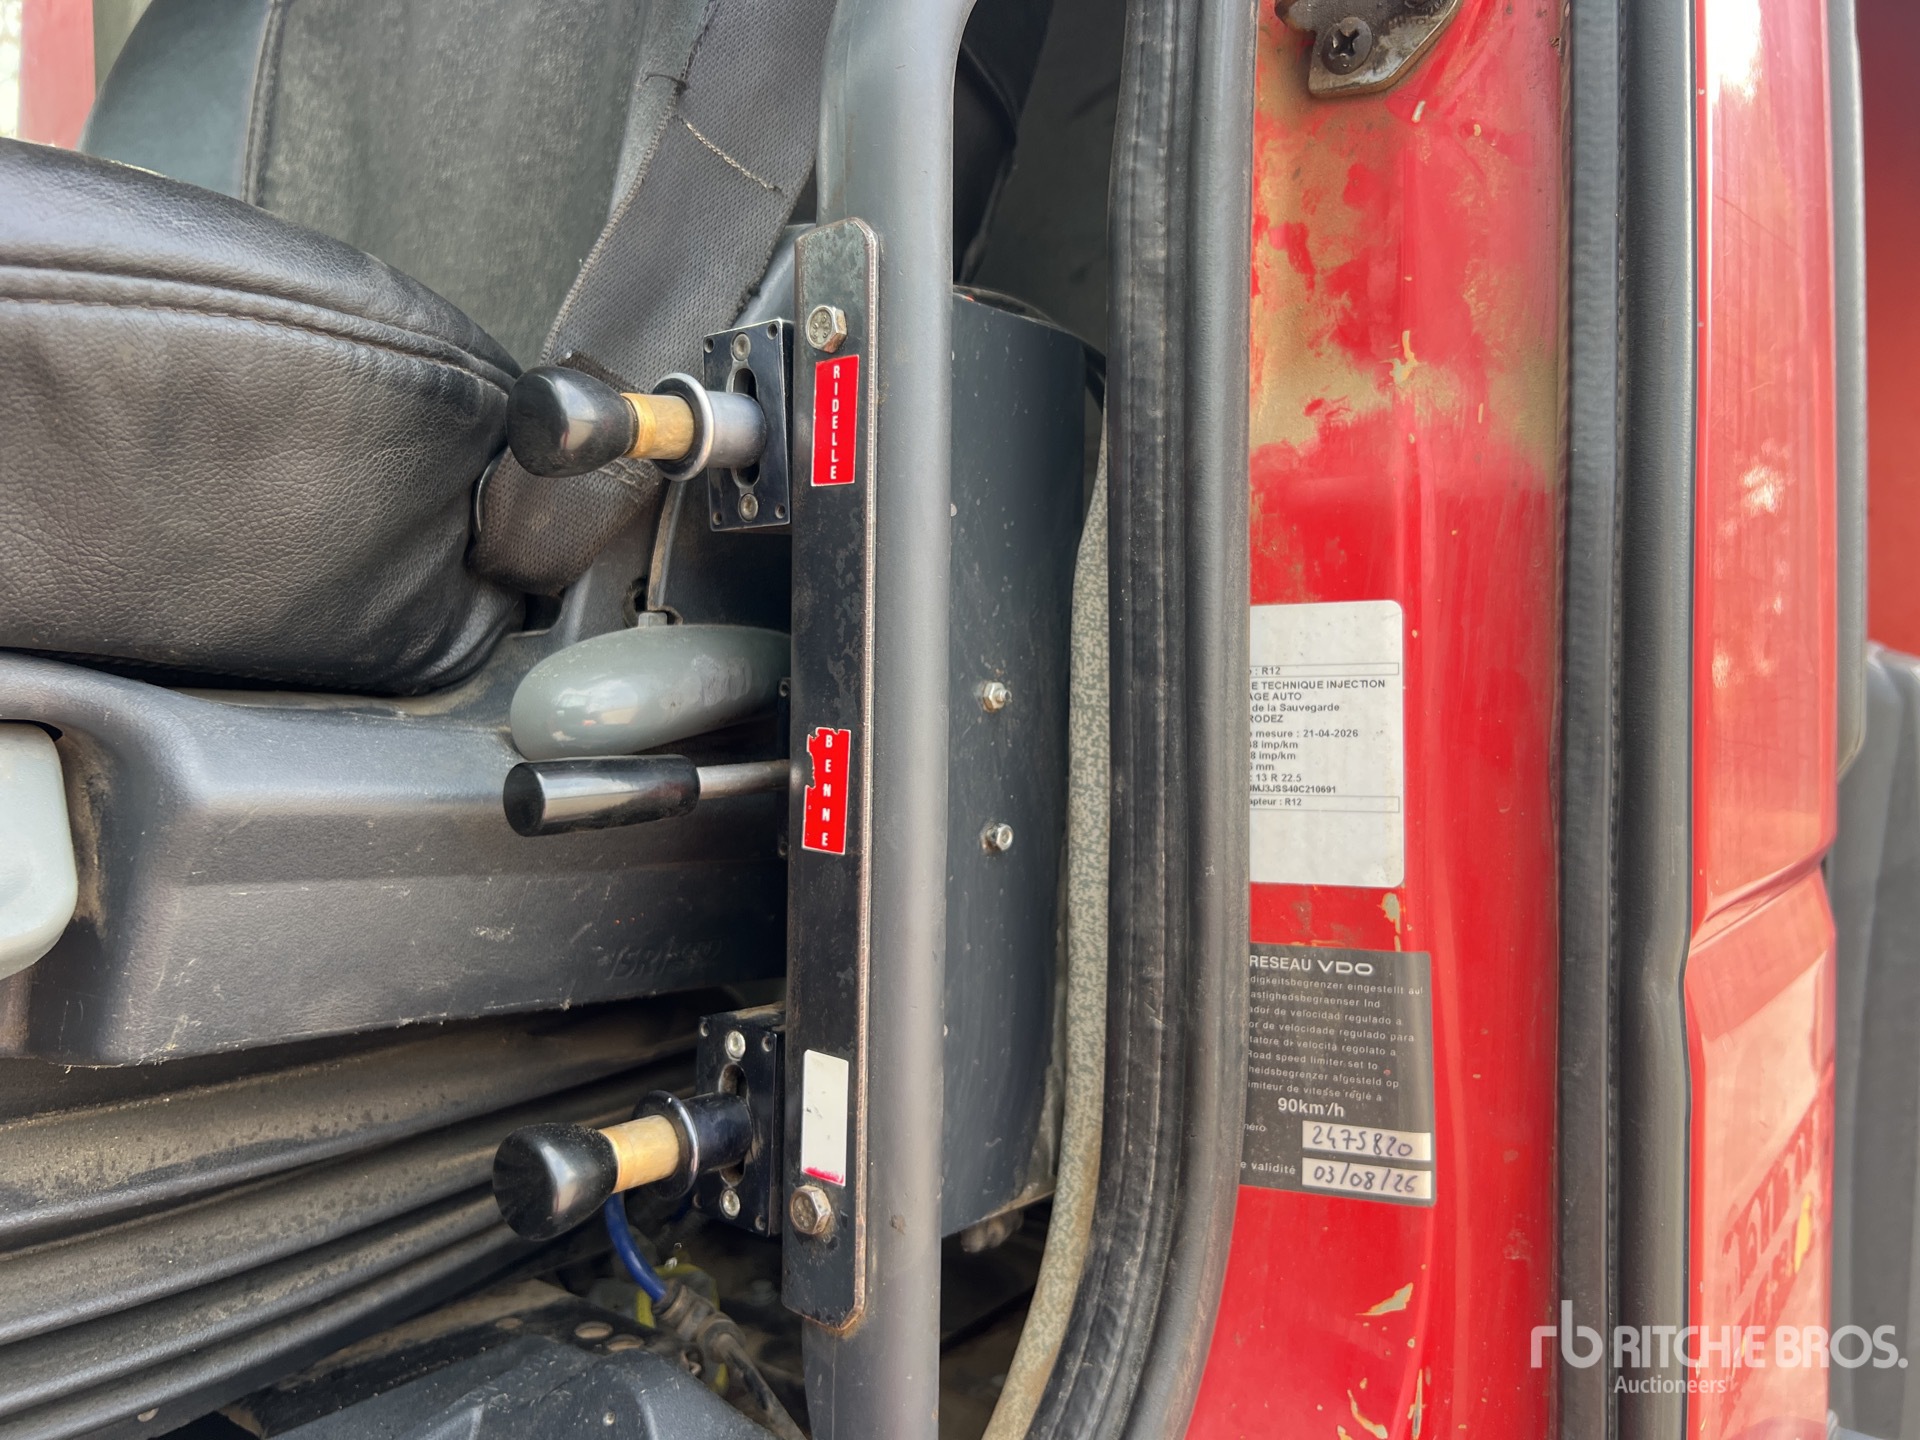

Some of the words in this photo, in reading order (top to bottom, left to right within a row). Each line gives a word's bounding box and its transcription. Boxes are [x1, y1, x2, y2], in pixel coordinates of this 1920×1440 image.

[830, 365, 840, 480] RIDELLE
[1262, 666, 1280, 675] R12
[1262, 681, 1324, 690] TECHNIQUE
[1326, 680, 1386, 689] INJECTION
[1272, 692, 1302, 701] AUTO
[1252, 704, 1264, 712] de
[1268, 704, 1276, 712] la
[1280, 703, 1340, 713] Sauvegarde
[1303, 729, 1358, 738] 21-04-2026
[1262, 740, 1298, 750] imp/km
[1259, 752, 1296, 762] imp/km
[1256, 774, 1267, 782] 13
[1271, 774, 1278, 782] R
[1282, 774, 1302, 782] 22.5
[822, 734, 832, 846] BENNE
[1284, 798, 1302, 806] R12
[1250, 955, 1311, 971] RESEAU
[1317, 960, 1374, 975] VDO
[1348, 983, 1404, 994] eingestellt
[1274, 1008, 1286, 1016] de
[1290, 1008, 1340, 1020] velocidad
[1344, 1013, 1392, 1025] regulado
[1263, 1022, 1275, 1030] de
[1279, 1024, 1335, 1036] velocidade
[1340, 1028, 1386, 1040] regulado
[1390, 1033, 1414, 1042] para
[1342, 1044, 1386, 1056] regolato
[1276, 1053, 1306, 1064] speed
[1310, 1055, 1344, 1066] limiter
[1348, 1060, 1364, 1070] set
[1368, 1062, 1378, 1070] to
[1333, 1073, 1382, 1086] afgesteld
[1386, 1080, 1399, 1089] op
[1287, 1084, 1299, 1093] de
[1304, 1087, 1341, 1098] vitesse
[1278, 1098, 1344, 1117] 90km/h
[1252, 1162, 1296, 1174] validité
[1314, 1163, 1418, 1194] 03/08/26
